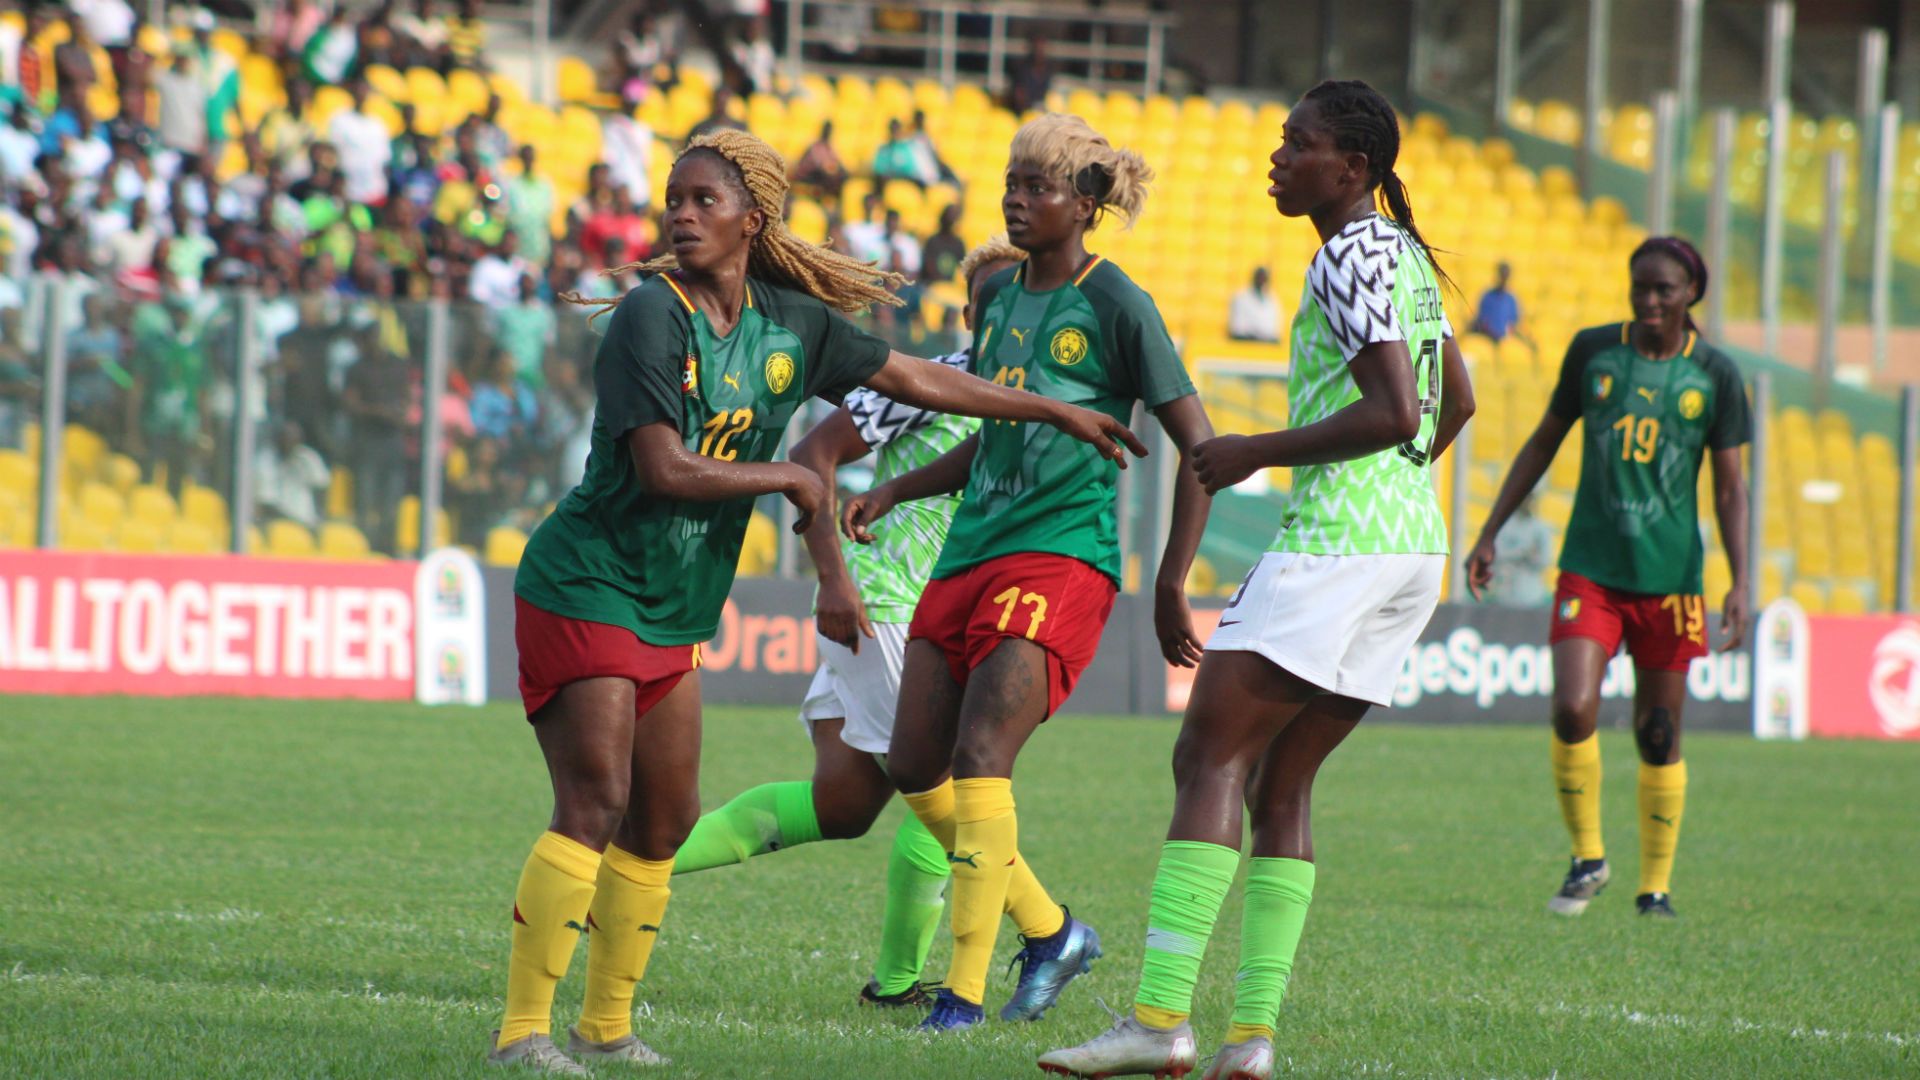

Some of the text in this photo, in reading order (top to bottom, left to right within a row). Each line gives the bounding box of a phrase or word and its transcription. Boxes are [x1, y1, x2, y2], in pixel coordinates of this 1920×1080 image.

[700, 408, 753, 462] 12
[1613, 413, 1660, 464] 19
[993, 586, 1048, 640] 17
